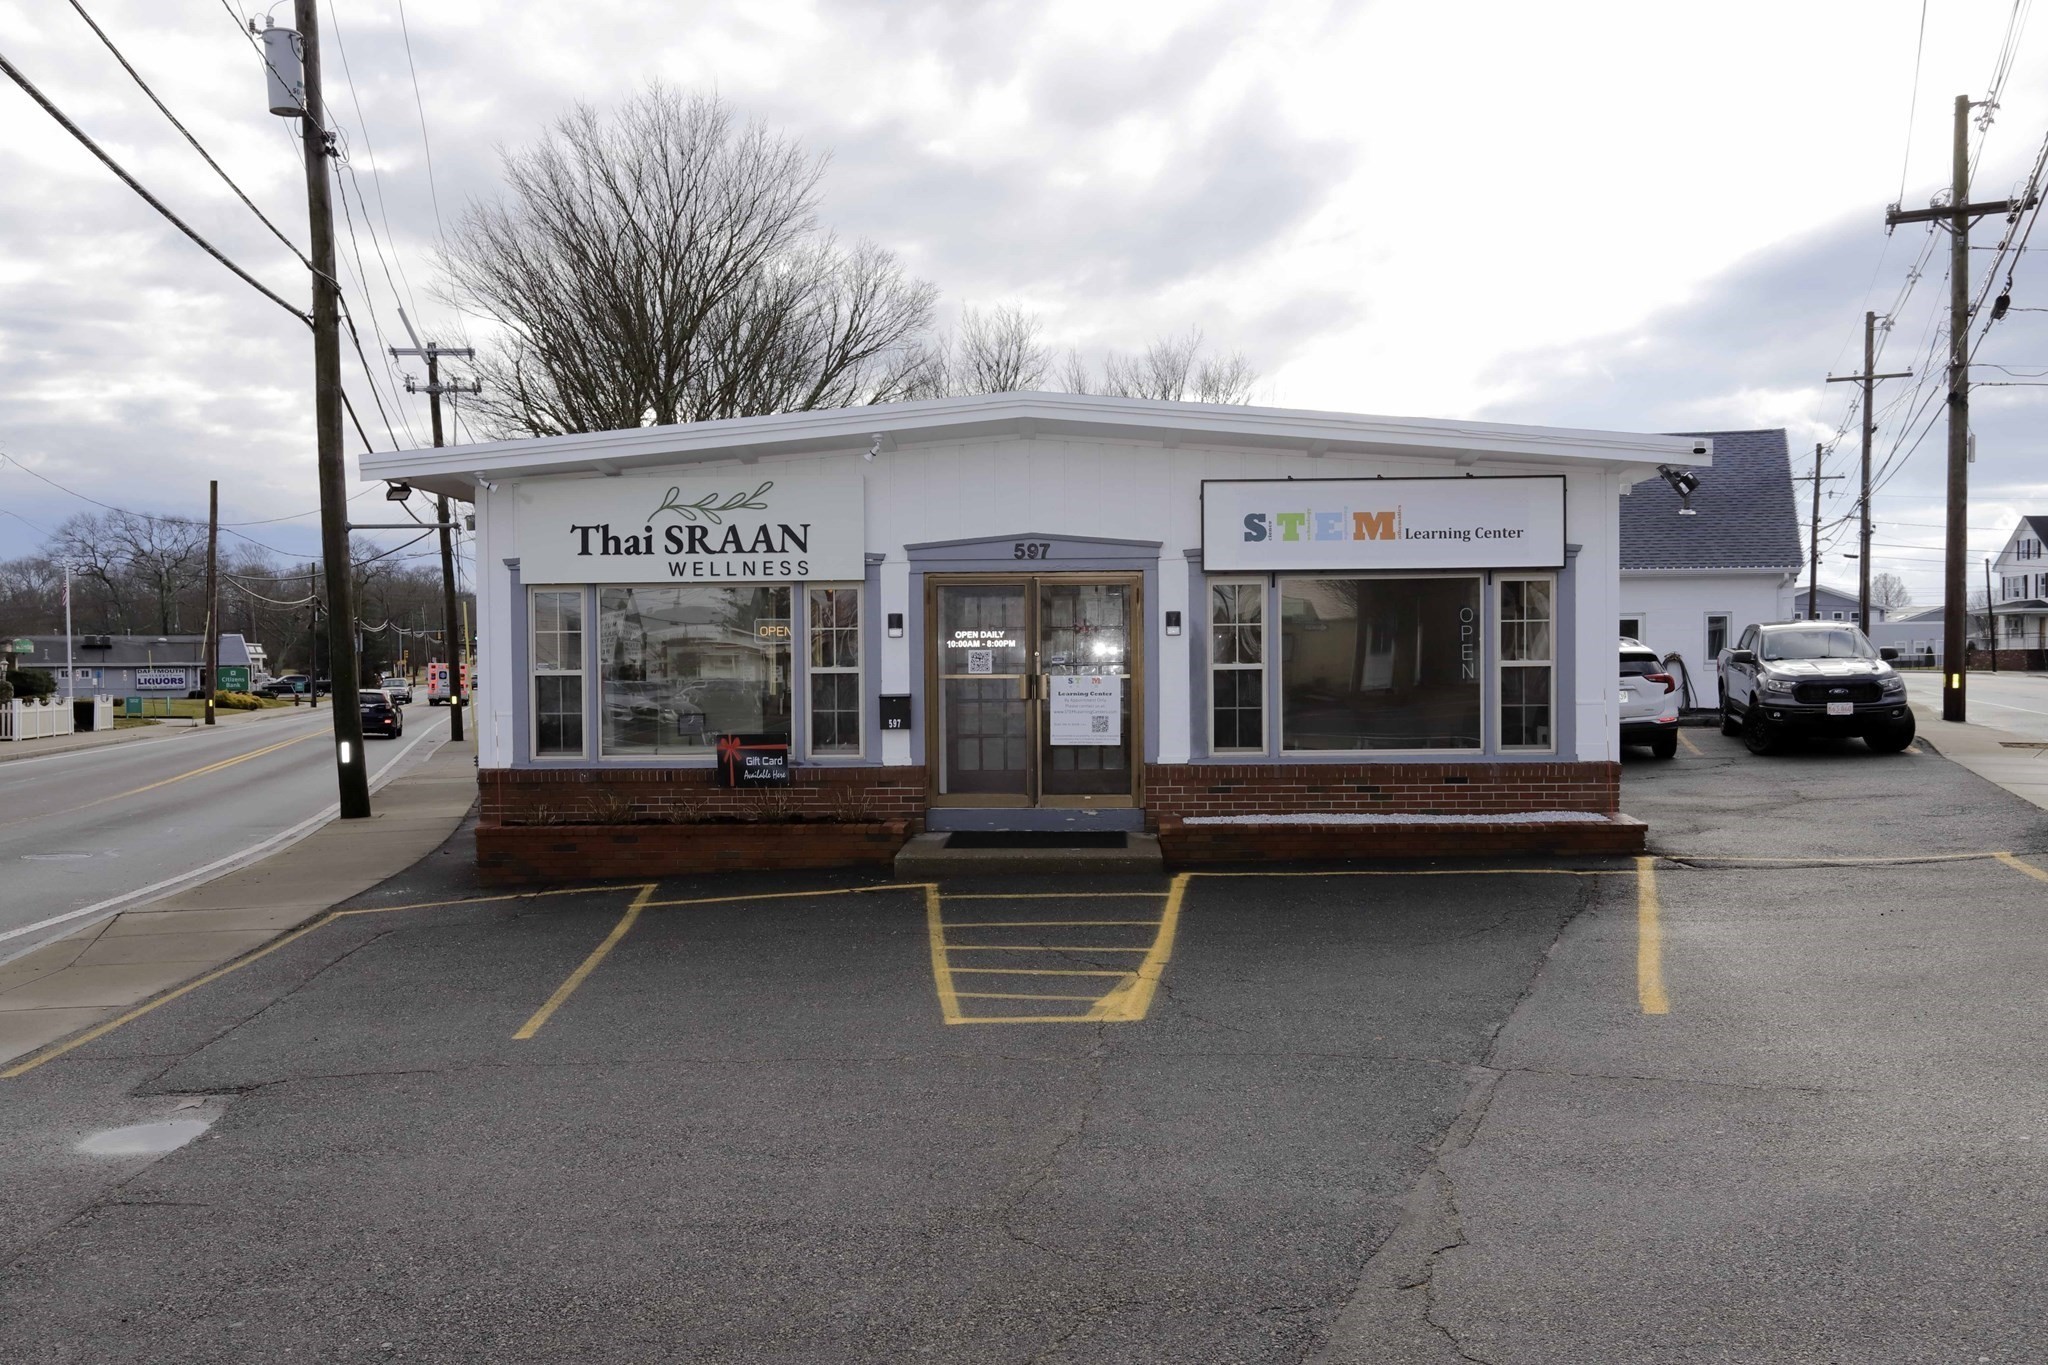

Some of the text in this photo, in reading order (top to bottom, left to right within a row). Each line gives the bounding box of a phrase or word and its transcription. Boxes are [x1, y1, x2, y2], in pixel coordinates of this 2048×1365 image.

[1243, 511, 1396, 542] STEM
[1405, 527, 1471, 542] Learning
[1475, 527, 1524, 539] Center
[570, 523, 811, 556] Thai SRAAN
[1013, 543, 1050, 560] 597
[668, 560, 809, 577] WELLNESS
[759, 626, 791, 637] OPEN
[955, 631, 978, 639] OPEN
[946, 640, 980, 648] 10:00AM
[986, 640, 1016, 648] 8:00PM
[1460, 607, 1474, 679] OPEN
[137, 677, 184, 685] LIQUORS
[888, 718, 901, 728] 597
[745, 756, 783, 766] Gift Card
[743, 769, 786, 780] Available Here
